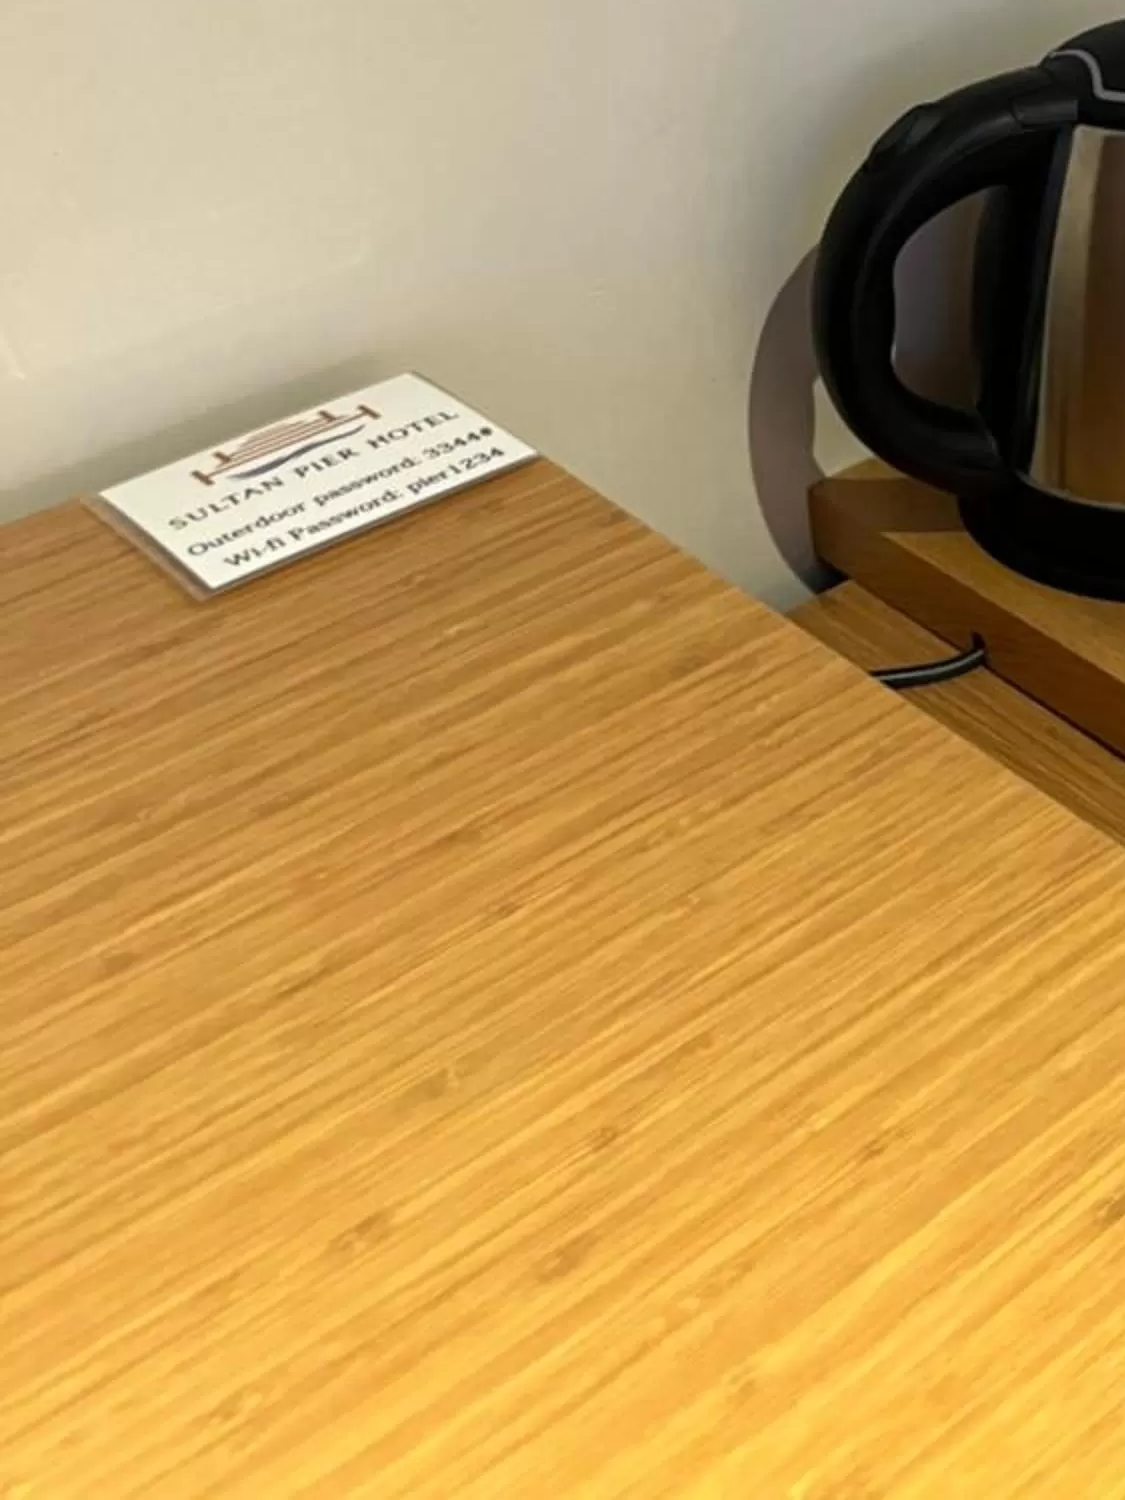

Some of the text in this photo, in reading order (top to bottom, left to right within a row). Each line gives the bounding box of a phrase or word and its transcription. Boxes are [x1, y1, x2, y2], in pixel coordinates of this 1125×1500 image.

[168, 411, 460, 530] SULTAN PIER HOTEL
[407, 446, 505, 495] pier1234
[187, 502, 306, 556] Outerdoor
